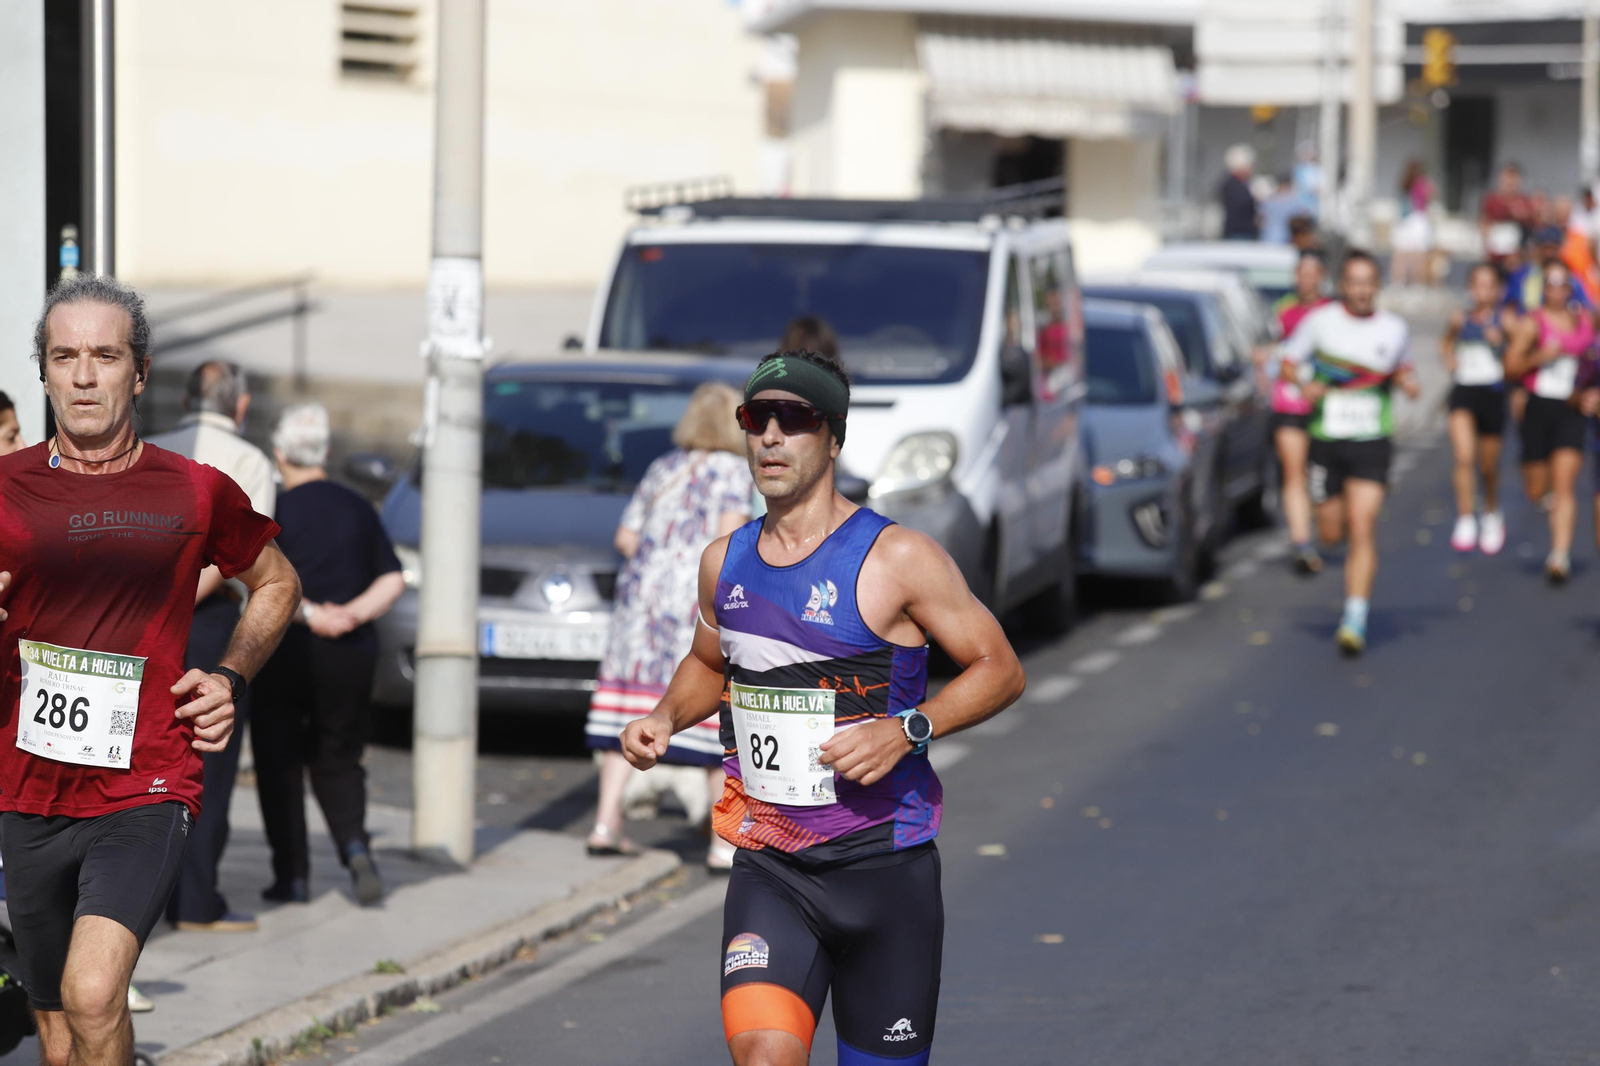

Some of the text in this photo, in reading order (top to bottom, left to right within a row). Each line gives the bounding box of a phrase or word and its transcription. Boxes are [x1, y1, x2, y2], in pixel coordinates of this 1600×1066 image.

[69, 511, 183, 529] GO RUNNING
[68, 533, 105, 541] MOVE
[29, 647, 134, 677] 34 VUELTA A HUELVA
[40, 677, 86, 692] ROMERO TRISAC
[48, 671, 70, 683] RAUL
[740, 692, 770, 709] VUELTA
[773, 695, 780, 710] A
[783, 695, 825, 711] HUELVA
[33, 688, 90, 732] 286
[746, 712, 772, 723] ISMAEL
[760, 723, 776, 731] LOPEZ
[43, 730, 83, 742] INDEPENDIENTE
[750, 733, 780, 771] 82
